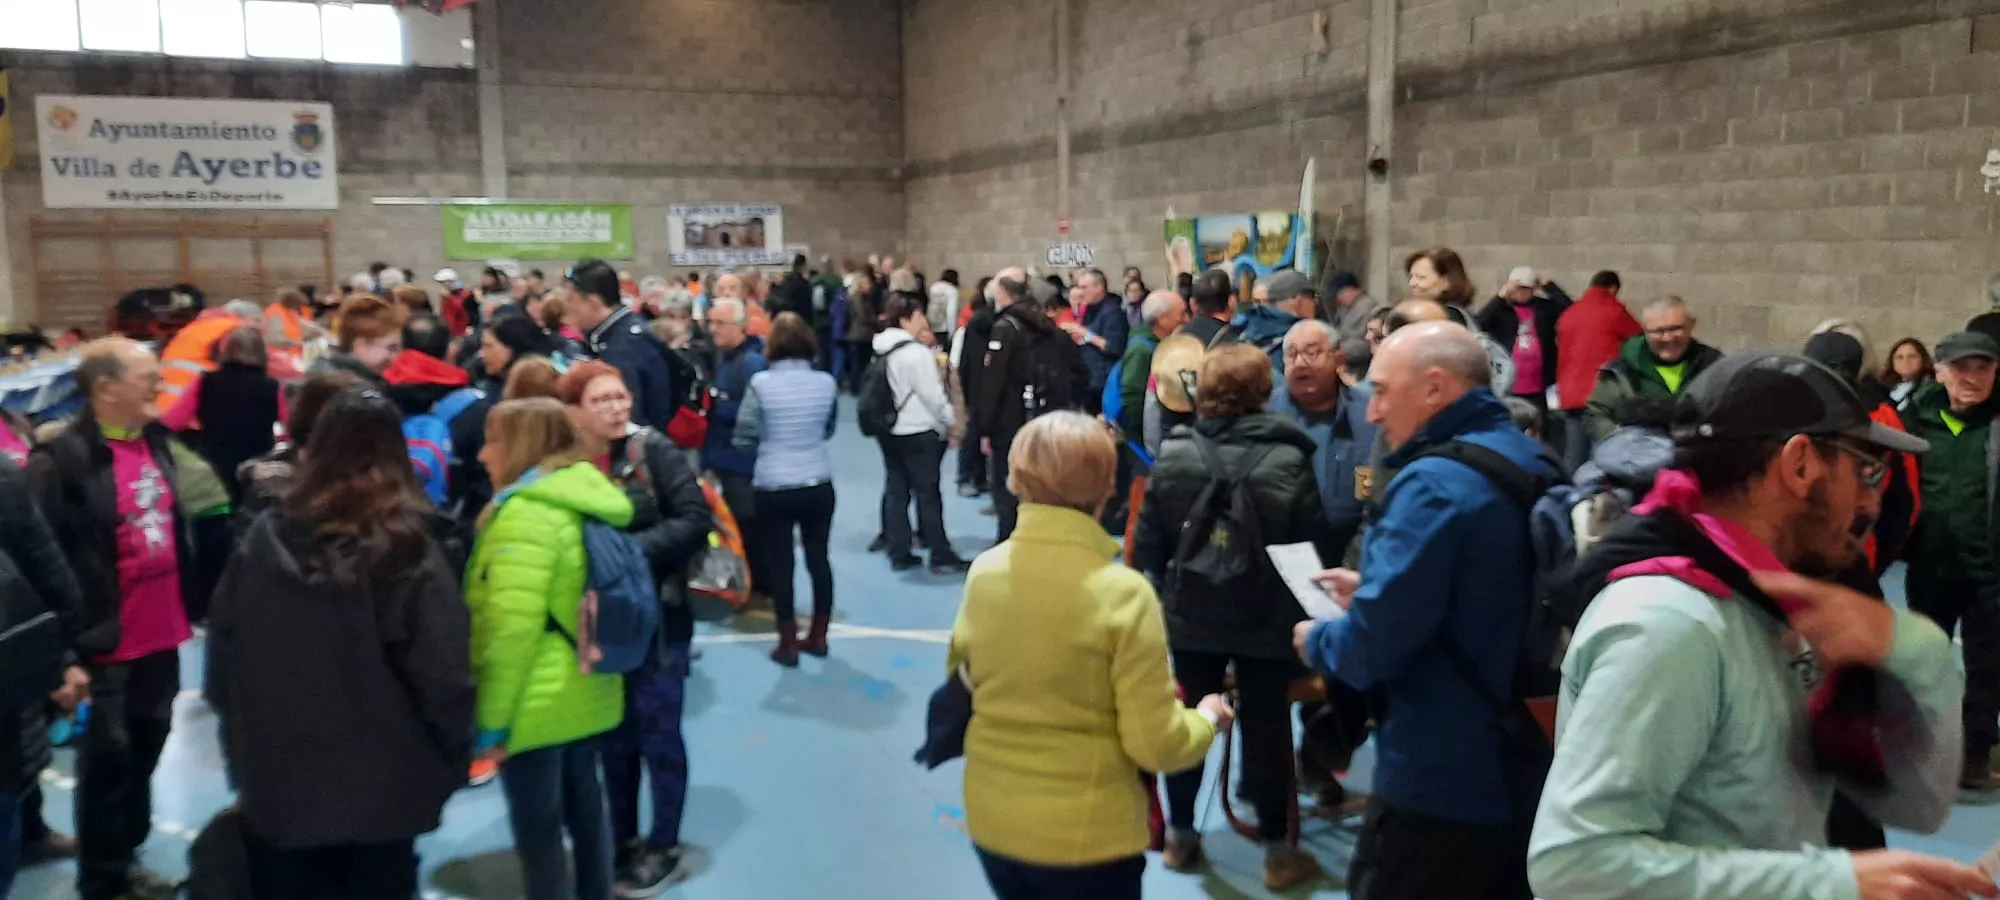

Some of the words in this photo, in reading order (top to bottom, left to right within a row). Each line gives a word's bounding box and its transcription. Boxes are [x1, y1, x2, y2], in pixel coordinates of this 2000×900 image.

[88, 118, 278, 143] Ayuntamiento
[50, 155, 117, 178] Villa
[128, 156, 161, 178] de
[171, 149, 324, 185] Ayerbe
